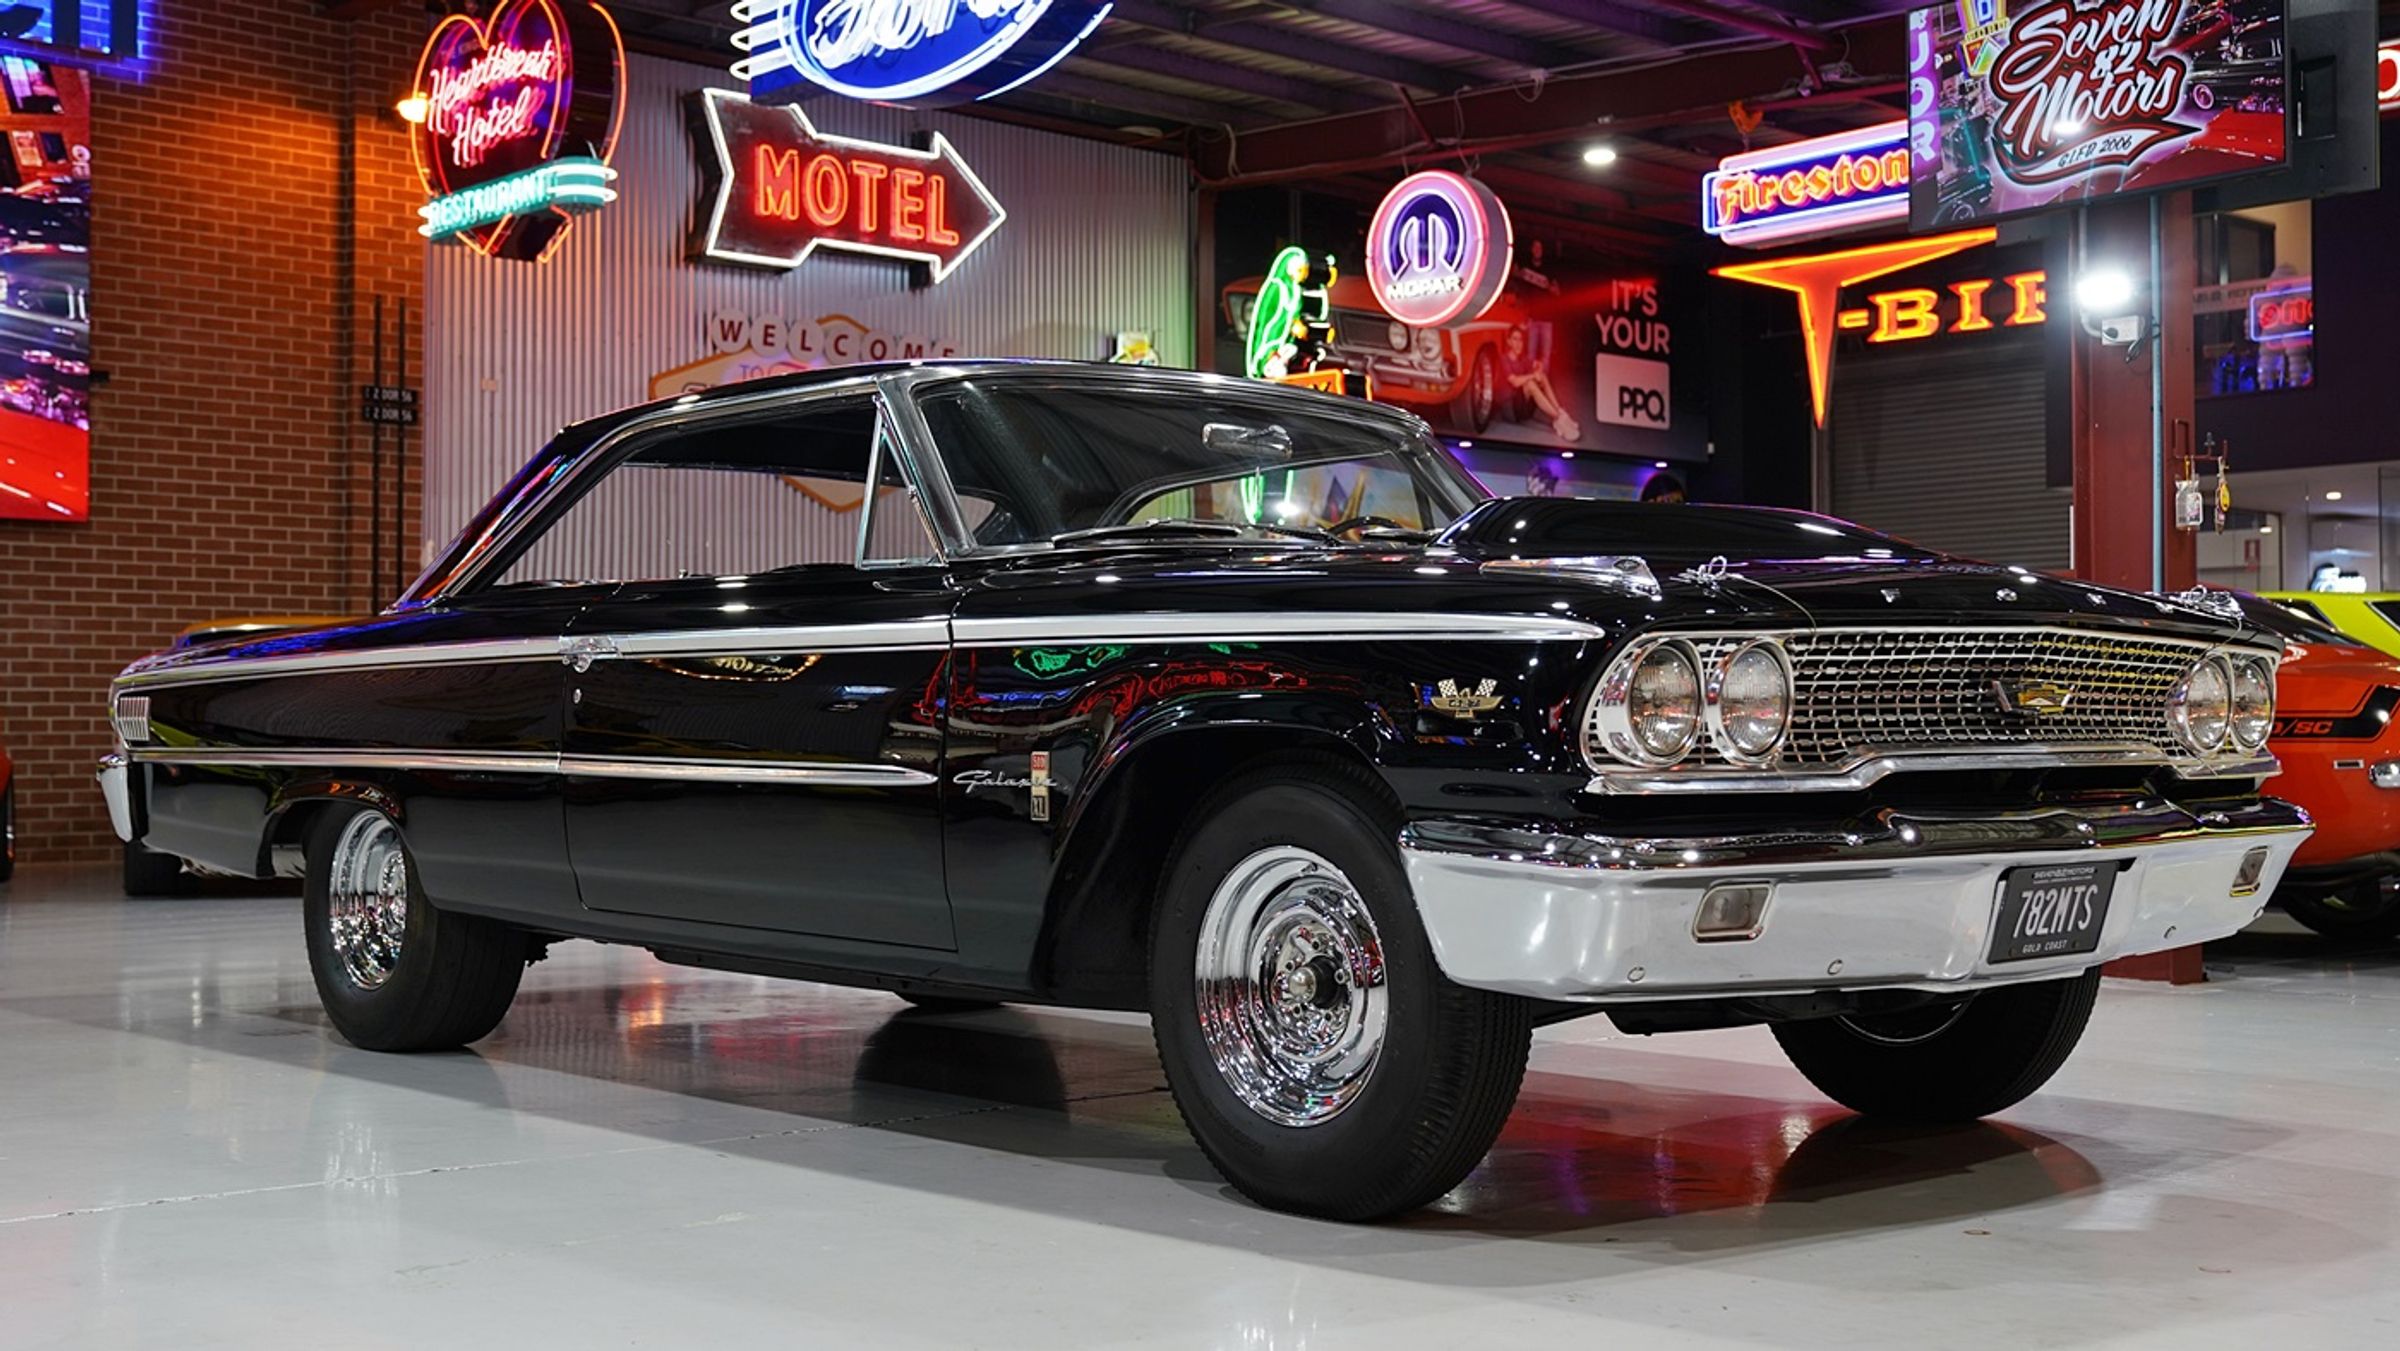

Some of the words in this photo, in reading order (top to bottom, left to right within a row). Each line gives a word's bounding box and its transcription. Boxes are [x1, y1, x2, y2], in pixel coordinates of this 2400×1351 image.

[1999, 0, 2174, 93] Seven
[428, 39, 553, 134] Heartbreak
[2002, 66, 2177, 155] Motors
[452, 86, 531, 166] Hotel
[2099, 135, 2132, 152] 2006
[429, 167, 551, 229] RESTAURANT
[754, 144, 960, 246] MOTEL
[1385, 274, 1462, 299] MOPAR
[1612, 279, 1658, 316] IT'S
[1595, 313, 1670, 355] YOUR
[1619, 385, 1666, 423] PPQ
[2013, 885, 2098, 938] 782MTS
[2044, 940, 2067, 950] COAST
